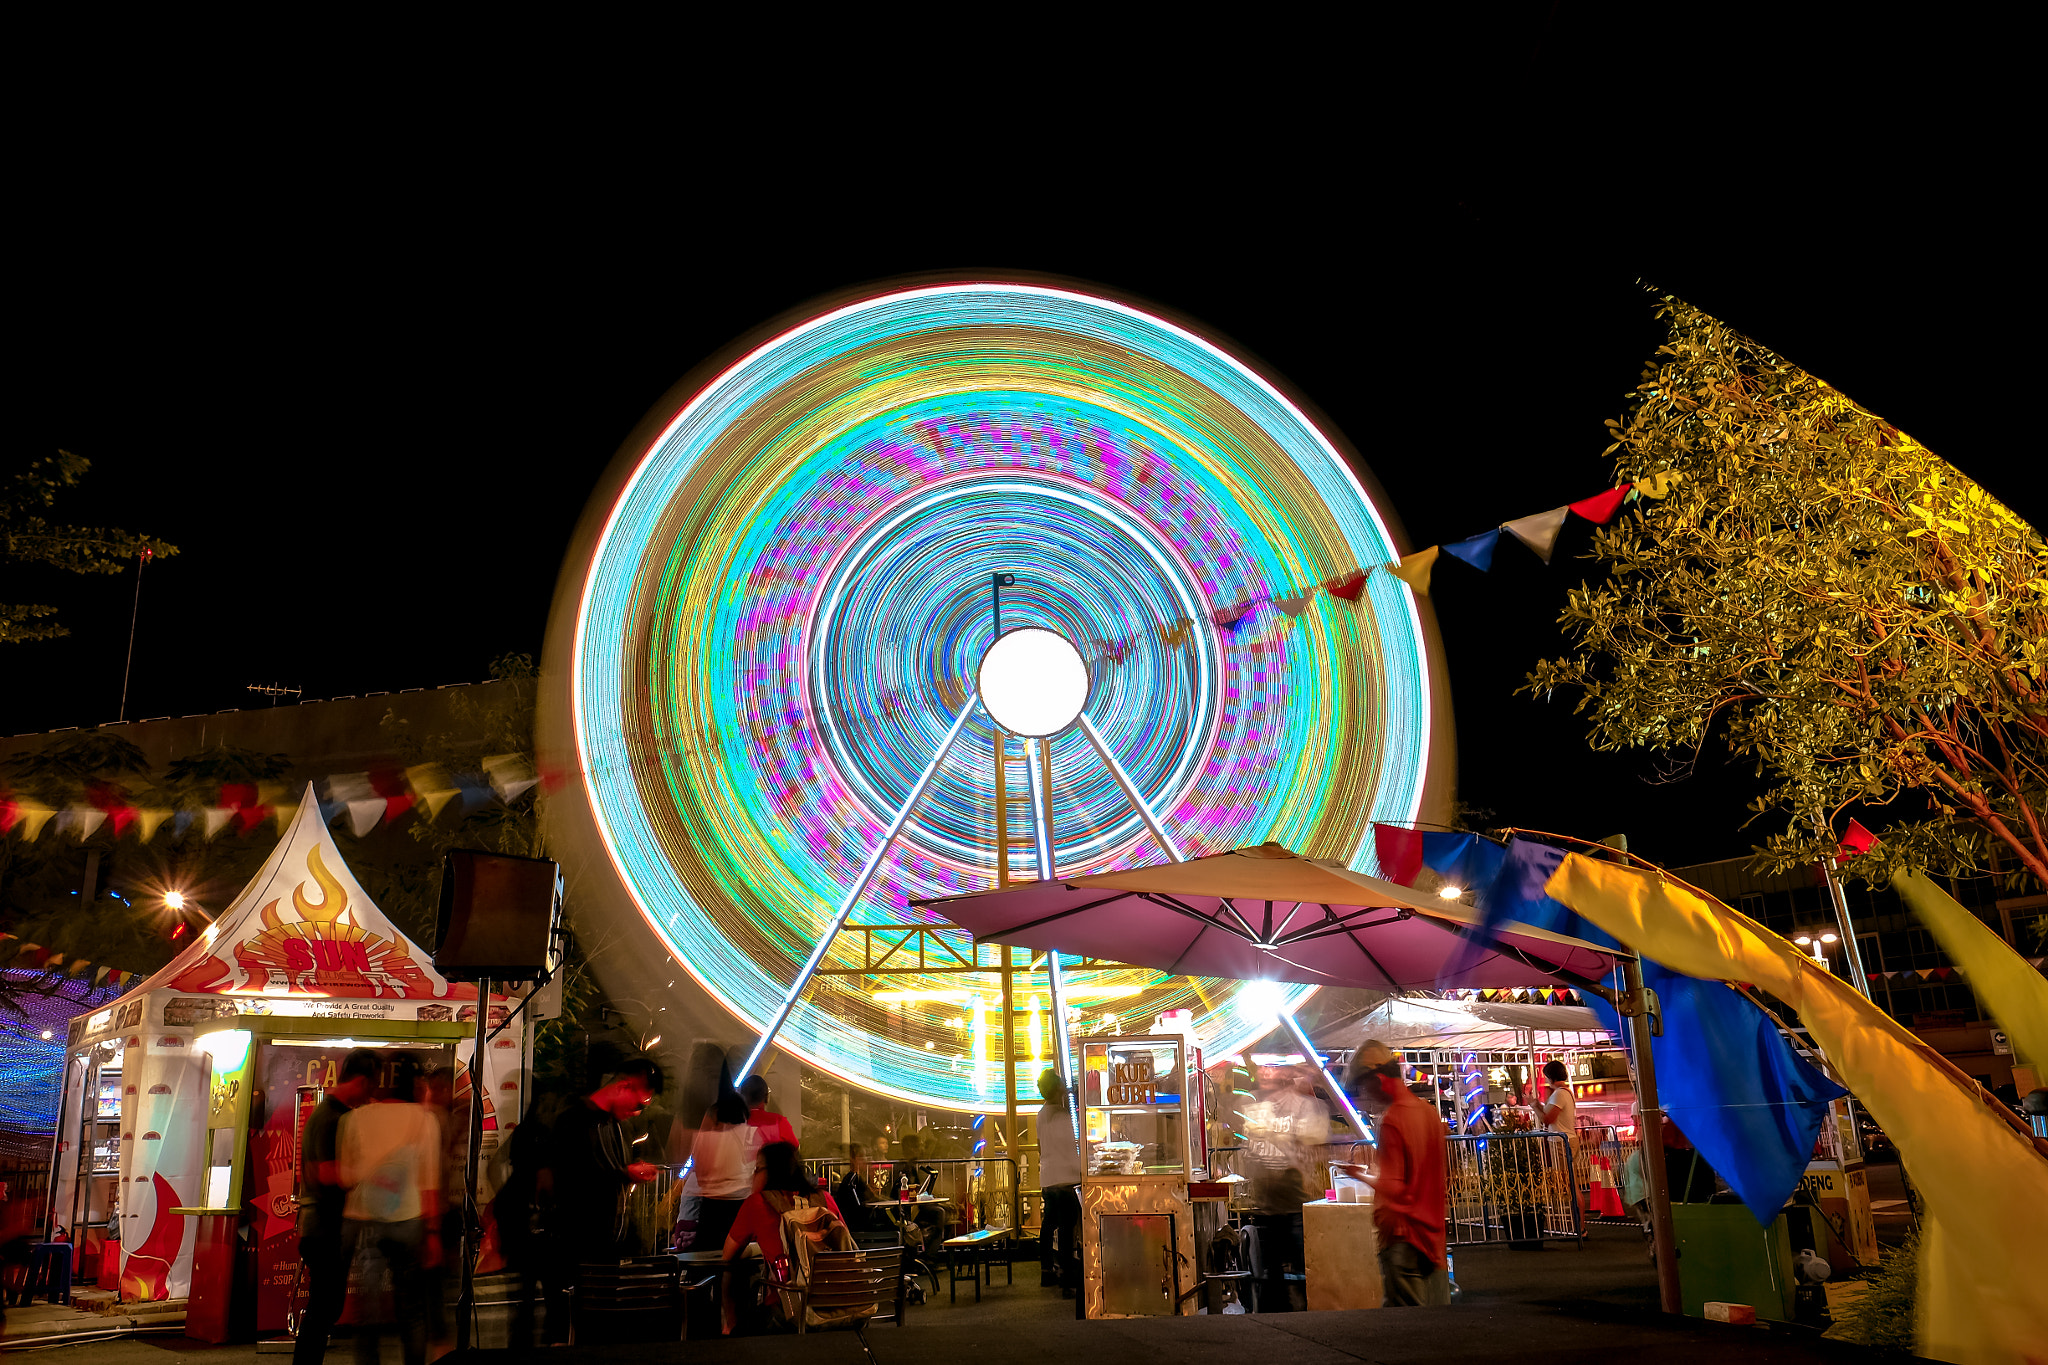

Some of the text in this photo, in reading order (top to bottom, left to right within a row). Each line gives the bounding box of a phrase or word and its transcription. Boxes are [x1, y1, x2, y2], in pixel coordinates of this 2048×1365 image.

[283, 938, 371, 972] SUN
[353, 1012, 385, 1020] Fireworks
[372, 1004, 395, 1012] Quality
[1116, 1063, 1150, 1083] KUE
[1107, 1083, 1157, 1105] CUBIT
